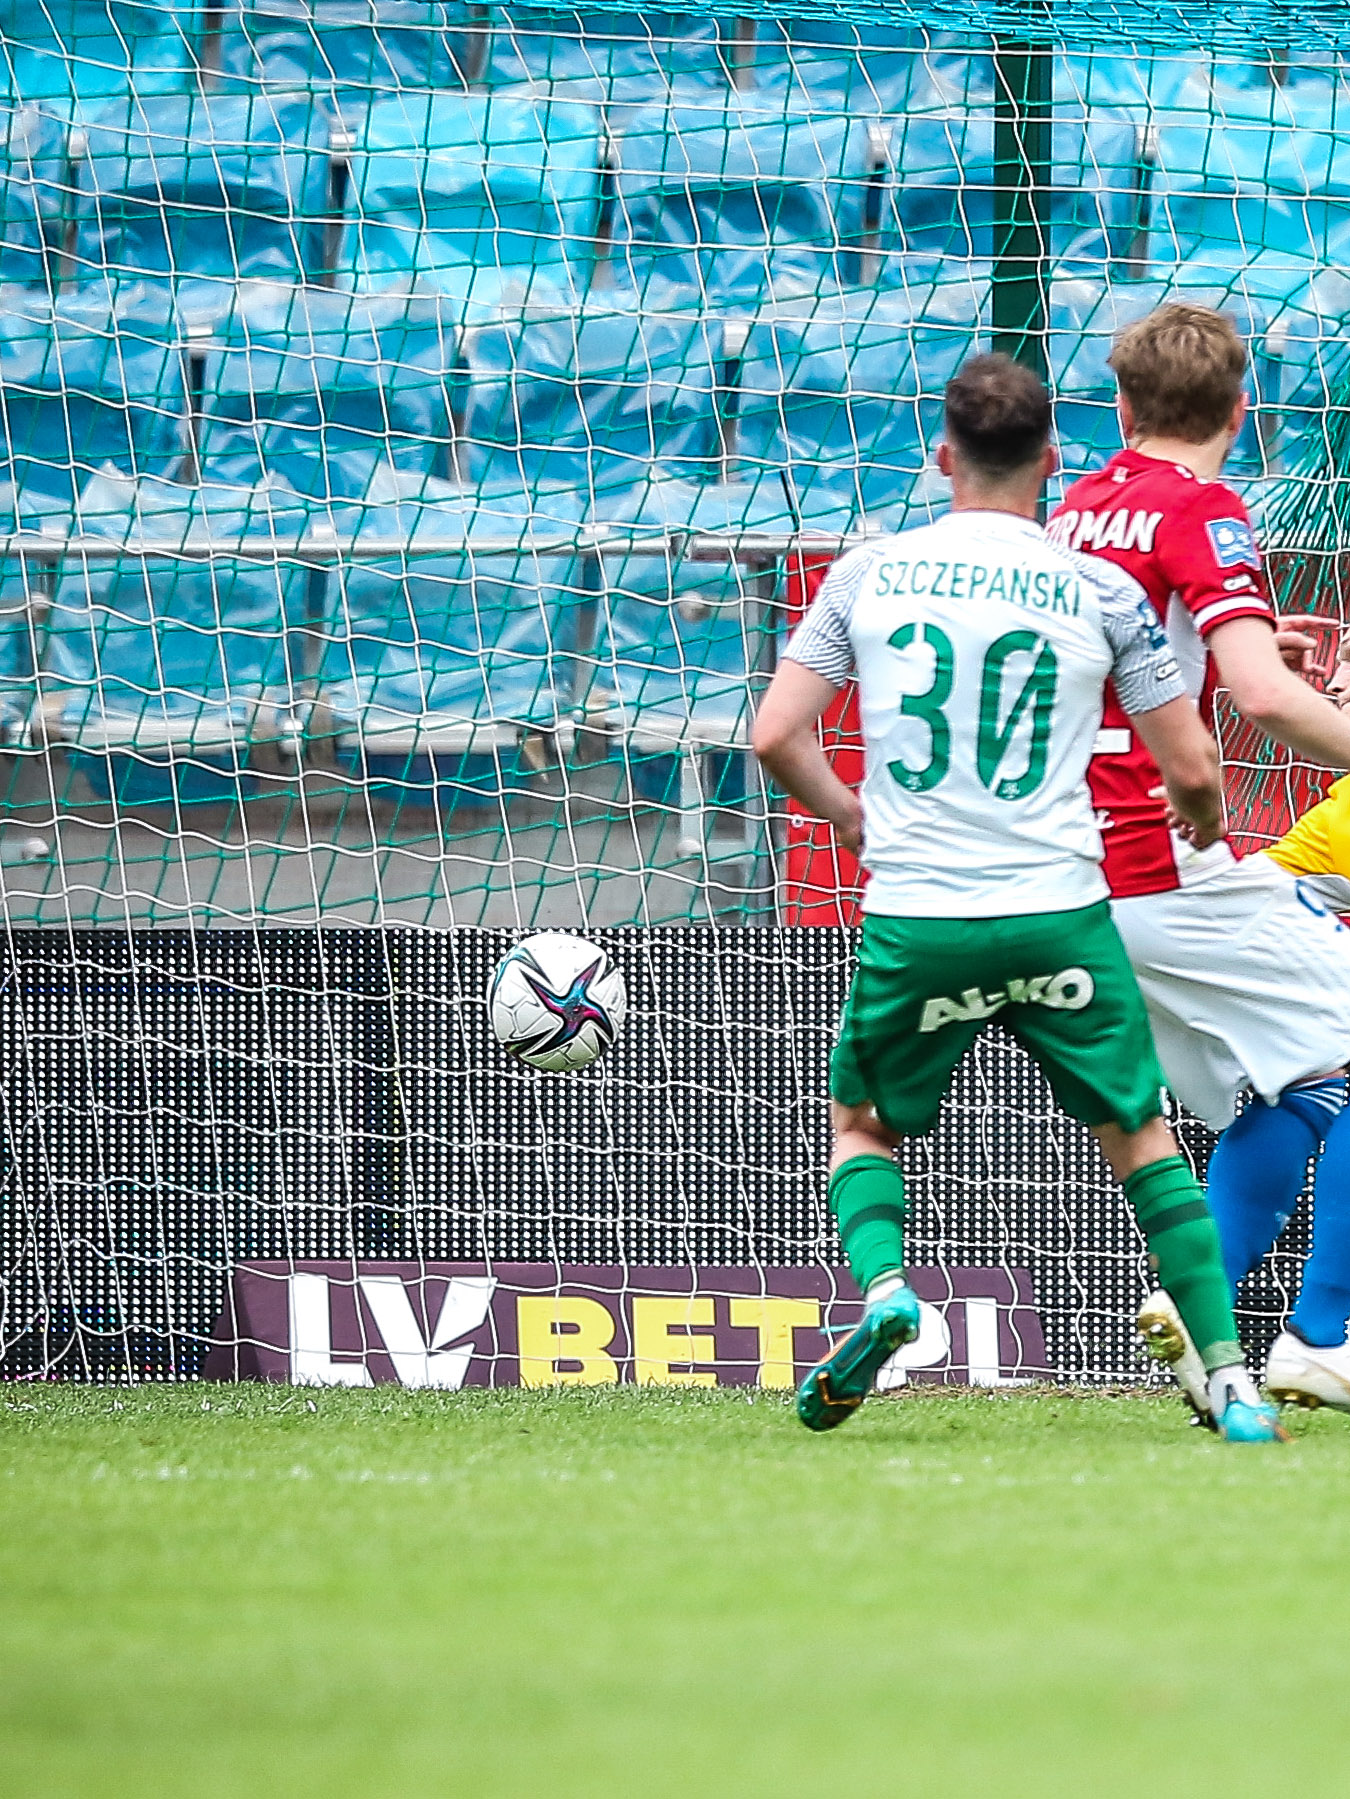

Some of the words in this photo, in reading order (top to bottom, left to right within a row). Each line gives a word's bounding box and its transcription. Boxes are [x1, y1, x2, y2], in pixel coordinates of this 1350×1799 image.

[875, 560, 1081, 617] SZCZEPAŃSKI
[887, 622, 1057, 799] 30
[918, 965, 1095, 1033] AL-KO
